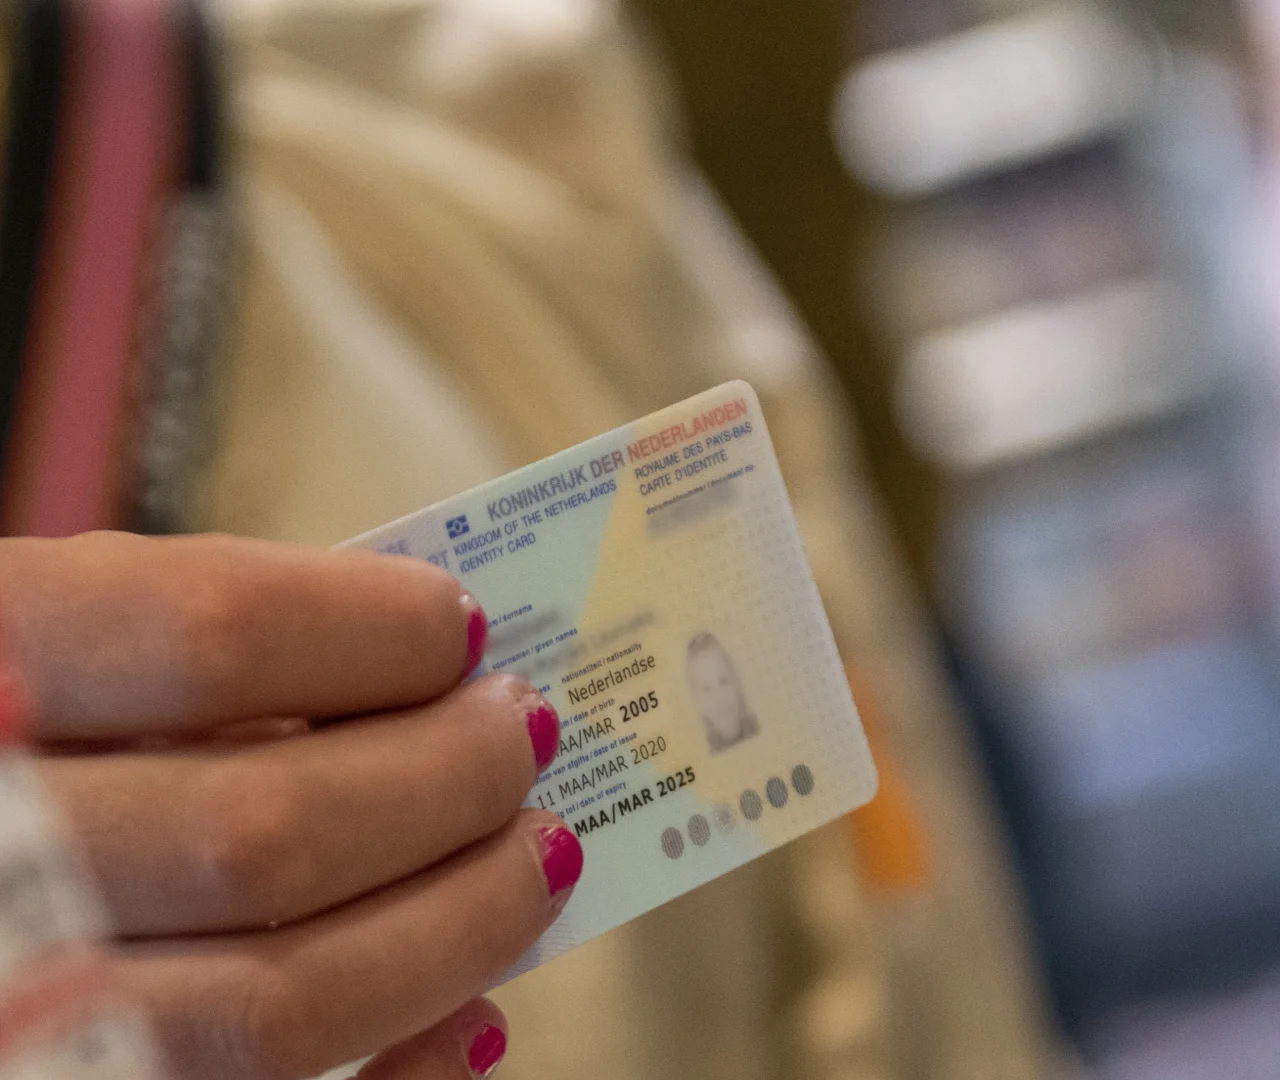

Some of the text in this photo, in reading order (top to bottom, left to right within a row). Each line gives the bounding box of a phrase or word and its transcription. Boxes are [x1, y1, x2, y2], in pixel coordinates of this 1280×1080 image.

[487, 464, 588, 522] KONINKRIJK
[589, 450, 625, 479] DER
[626, 398, 748, 462] NEDERLANDEN
[634, 421, 753, 480] ROYAUME DES PAYS-BAS
[639, 474, 673, 496] CARTE
[453, 479, 617, 557] KINGDOM OF THE NETHERLANDS
[459, 545, 506, 575] IDENTITY
[507, 533, 536, 554] CARD
[502, 604, 532, 621] surname
[535, 638, 554, 654] given
[555, 628, 578, 643] names
[606, 643, 642, 663] nationality
[568, 655, 657, 705] Nederlandse
[555, 690, 659, 758] AA/MAR 2005
[573, 711, 589, 722] date
[599, 698, 616, 710] birth
[538, 736, 667, 810] 11 MAA/MAR 2020
[553, 765, 566, 776] van
[593, 745, 609, 757] date
[618, 732, 637, 745] issue
[573, 766, 696, 838] MAA/MAR 2025
[580, 796, 595, 808] date
